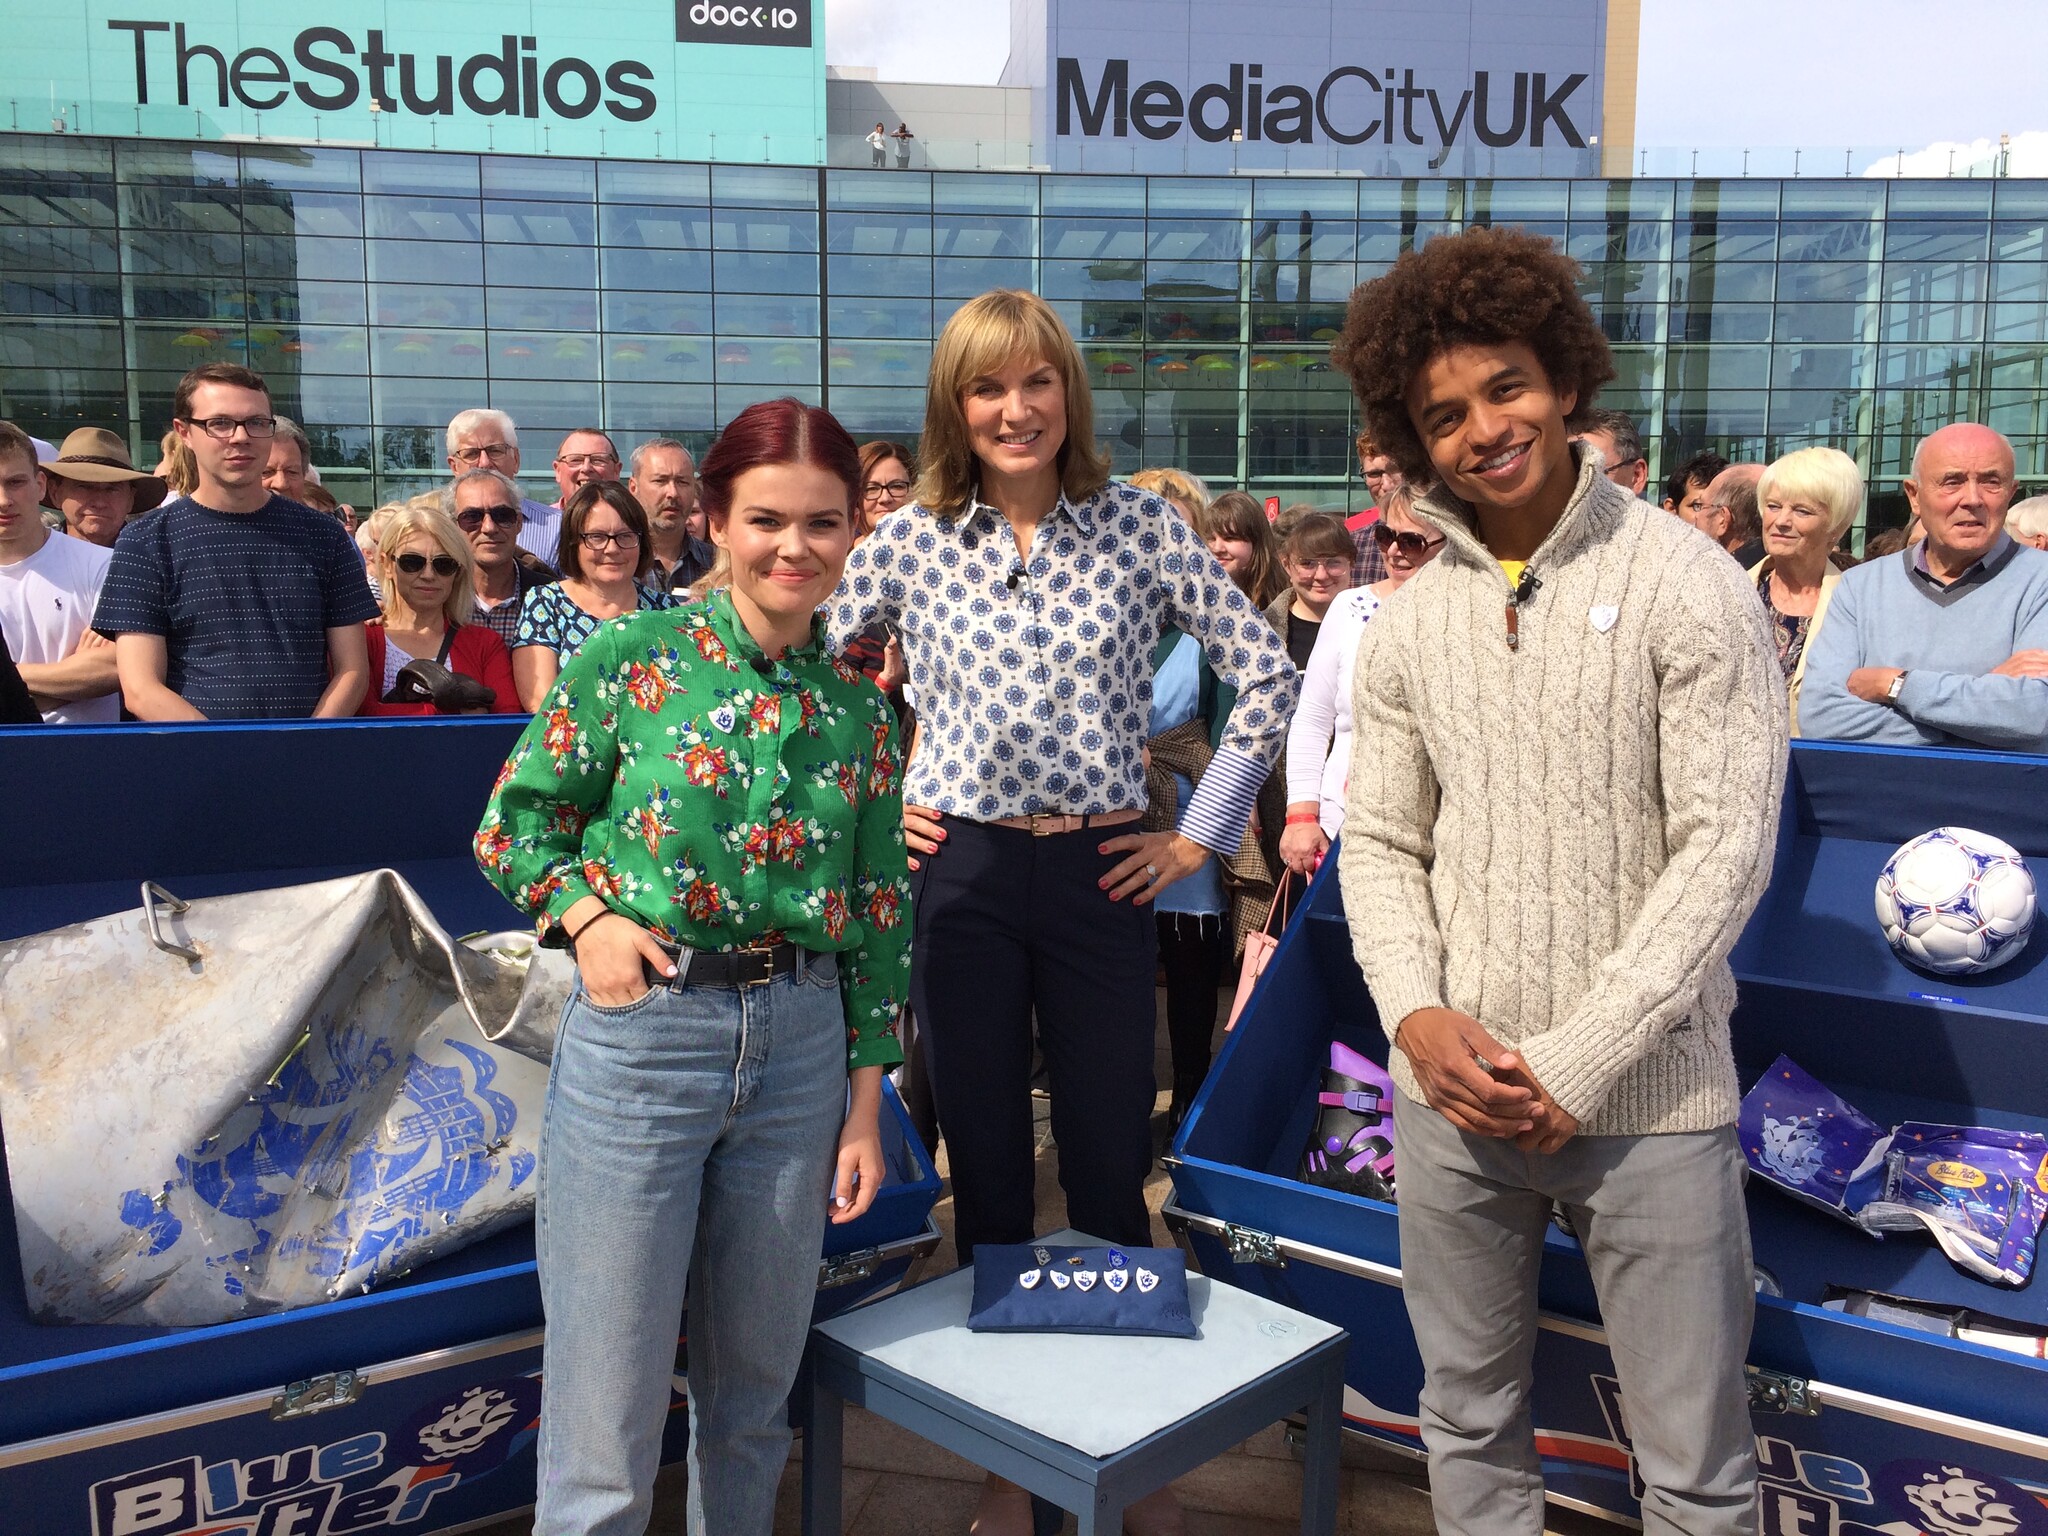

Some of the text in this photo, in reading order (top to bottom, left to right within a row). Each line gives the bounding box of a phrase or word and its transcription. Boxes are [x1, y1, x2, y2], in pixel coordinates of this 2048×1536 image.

[107, 19, 658, 123] TheStudios
[1056, 57, 1589, 170] MediaCityUK
[1935, 1163, 1979, 1180] Blue Peter
[90, 1431, 387, 1536] Blue
[212, 1472, 462, 1536] ter
